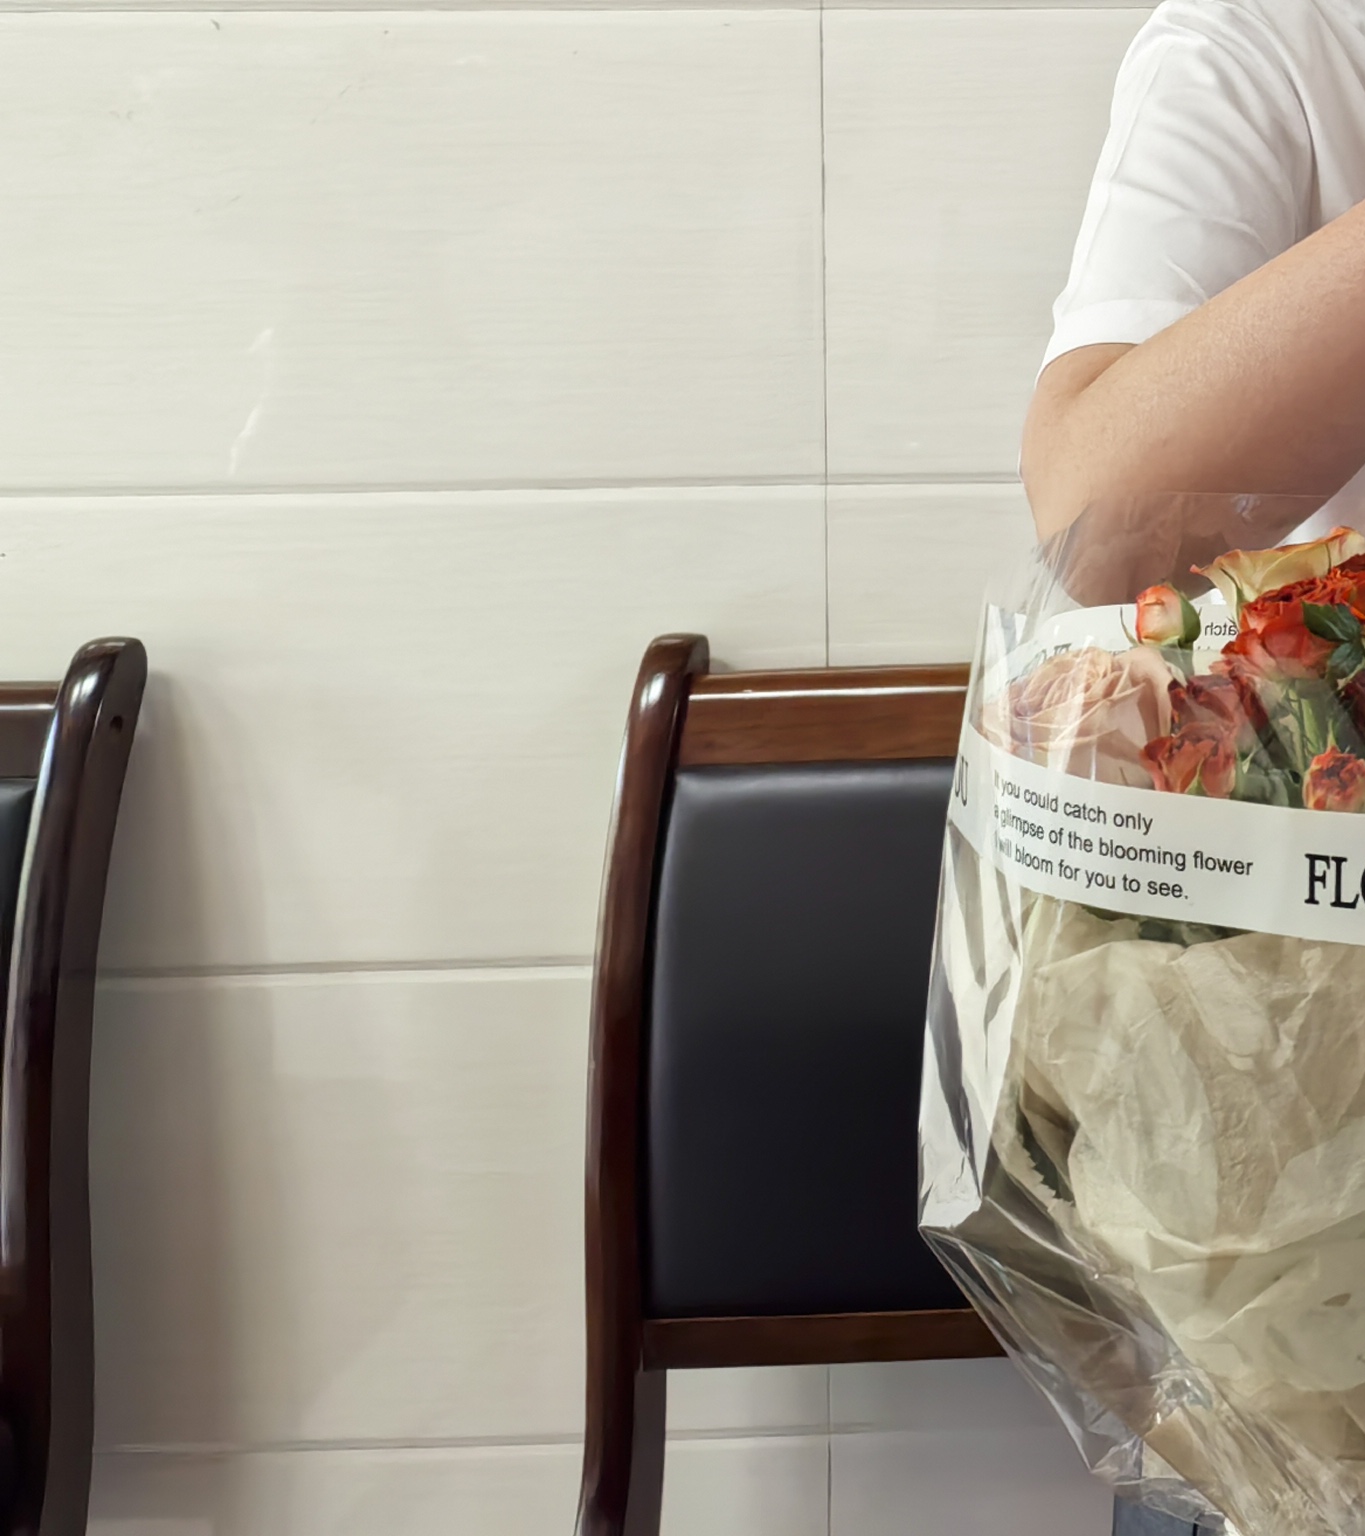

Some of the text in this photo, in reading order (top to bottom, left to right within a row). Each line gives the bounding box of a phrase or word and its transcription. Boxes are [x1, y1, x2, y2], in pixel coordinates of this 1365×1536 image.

[1001, 778, 1020, 799] you
[1023, 788, 1059, 813] could
[1063, 800, 1108, 825] catch
[1112, 811, 1154, 836] only
[1000, 807, 1045, 840] glimpse
[1049, 827, 1064, 846] of
[1068, 831, 1094, 853] the
[1099, 836, 1187, 872] blooming
[1192, 851, 1254, 876] flower
[1014, 843, 1054, 875] bloom
[1058, 858, 1081, 881] for
[1085, 868, 1116, 890] you
[1122, 874, 1141, 894] to
[1146, 880, 1190, 900] see.
